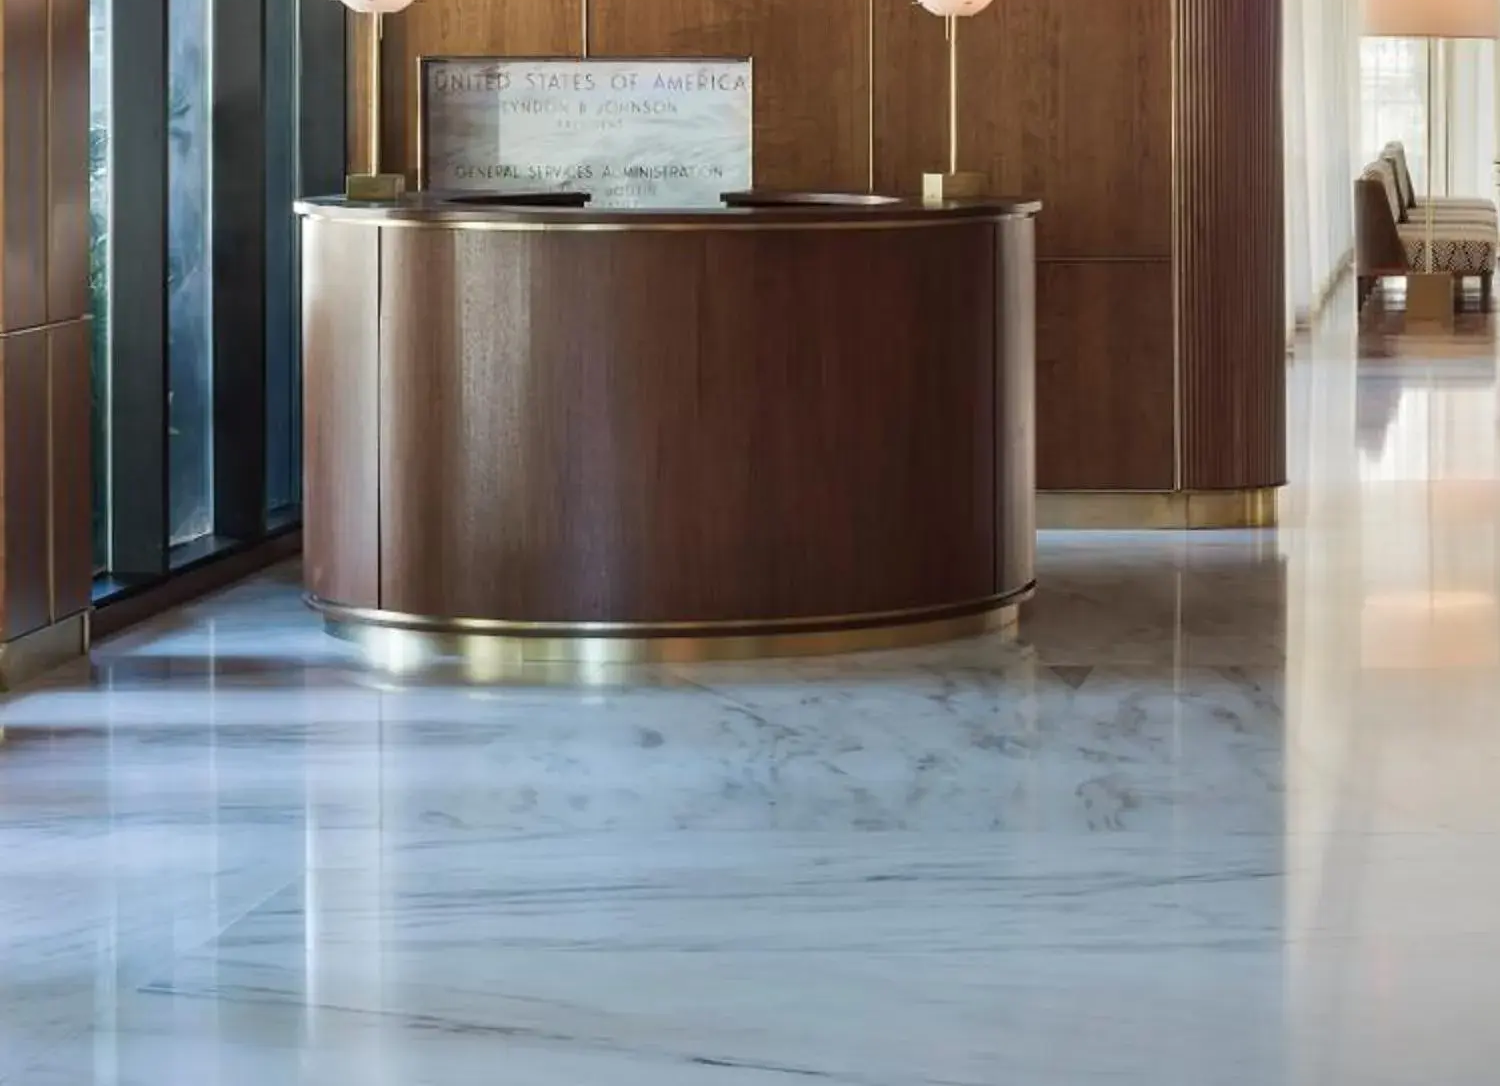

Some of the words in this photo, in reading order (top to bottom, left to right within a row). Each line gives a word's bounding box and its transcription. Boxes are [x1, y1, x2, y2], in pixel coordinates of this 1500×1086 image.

[434, 71, 511, 91] UNITED
[526, 72, 595, 91] STATES
[610, 73, 639, 91] OF
[653, 72, 748, 92] AMERICA
[502, 99, 568, 114] LYNDON
[597, 100, 678, 114] JOHNSON
[455, 165, 521, 179] GENERAL
[602, 165, 723, 179] AMINISTRATON
